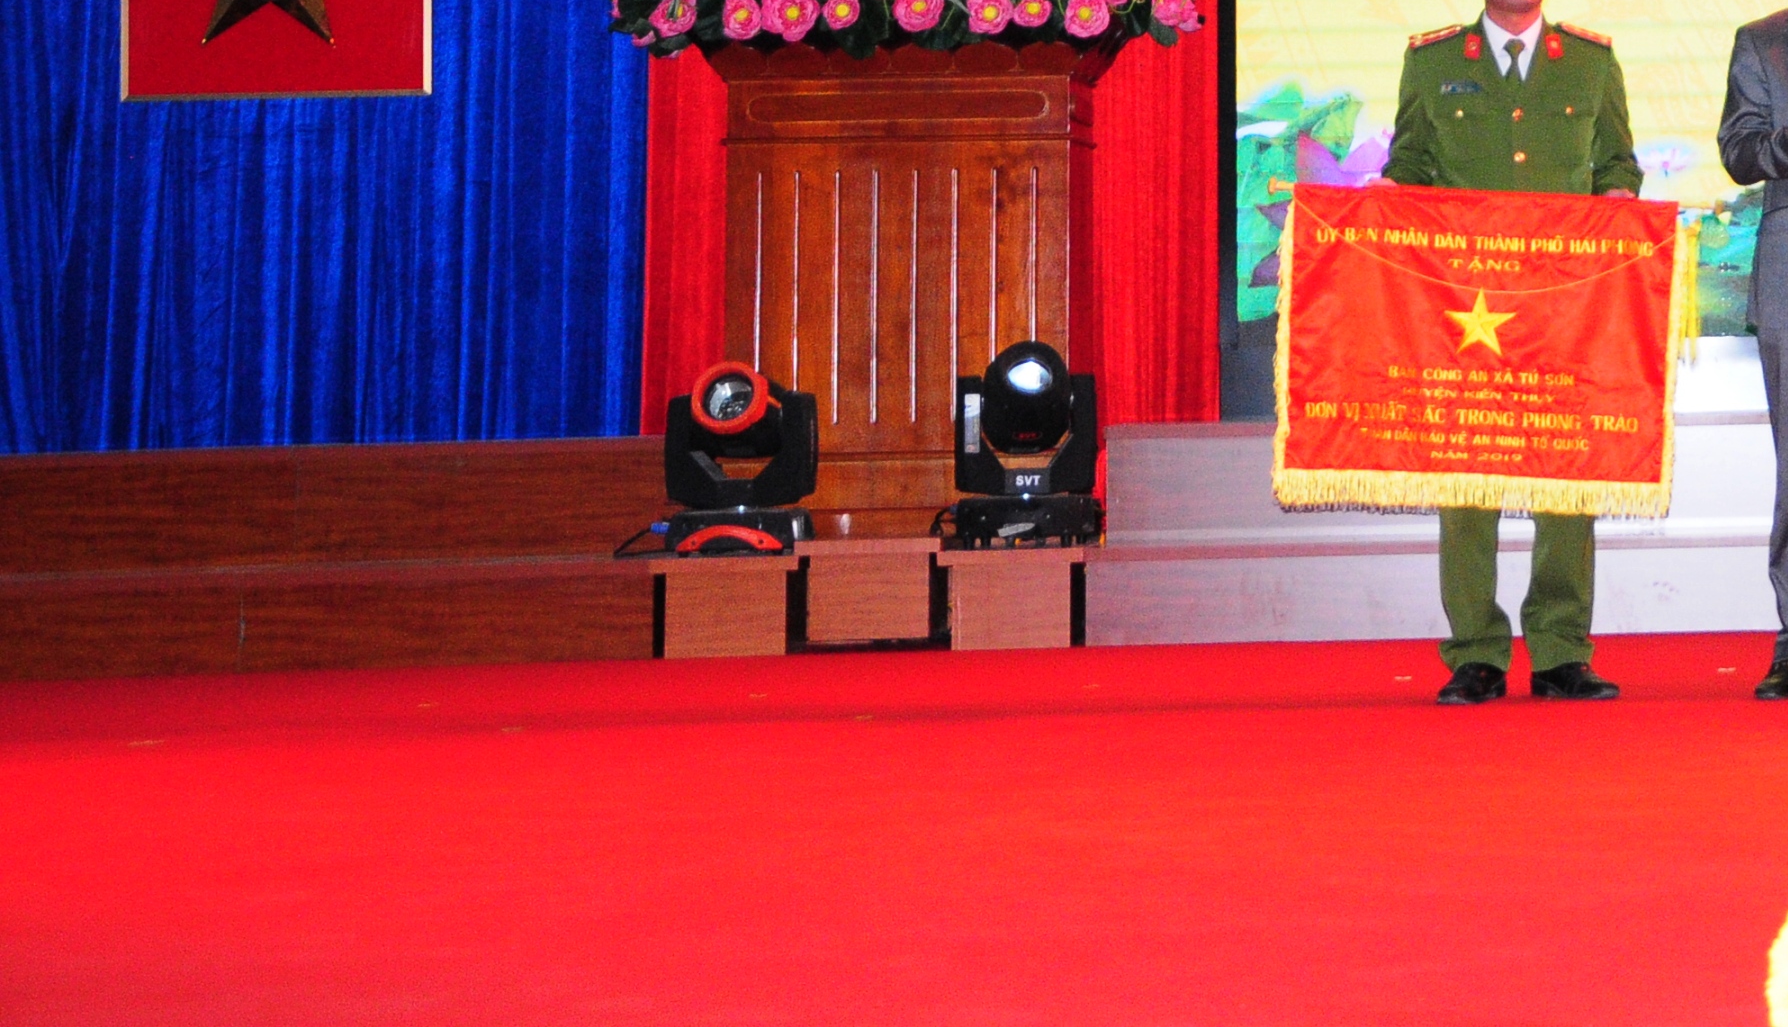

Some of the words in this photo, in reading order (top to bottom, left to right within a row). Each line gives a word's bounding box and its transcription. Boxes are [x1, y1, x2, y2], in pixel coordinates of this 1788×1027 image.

[1384, 226, 1428, 247] NHÂN
[1448, 256, 1520, 273] TẶNG
[1422, 366, 1462, 381] CÔNG
[1468, 369, 1488, 382] AN
[1305, 401, 1337, 418] ĐƠN
[1456, 408, 1514, 427] TRONG
[1522, 411, 1581, 430] PHONG
[1472, 434, 1490, 445] AN
[1496, 435, 1525, 448] NINH
[1477, 452, 1523, 461] 2019
[1015, 475, 1041, 487] SVT
